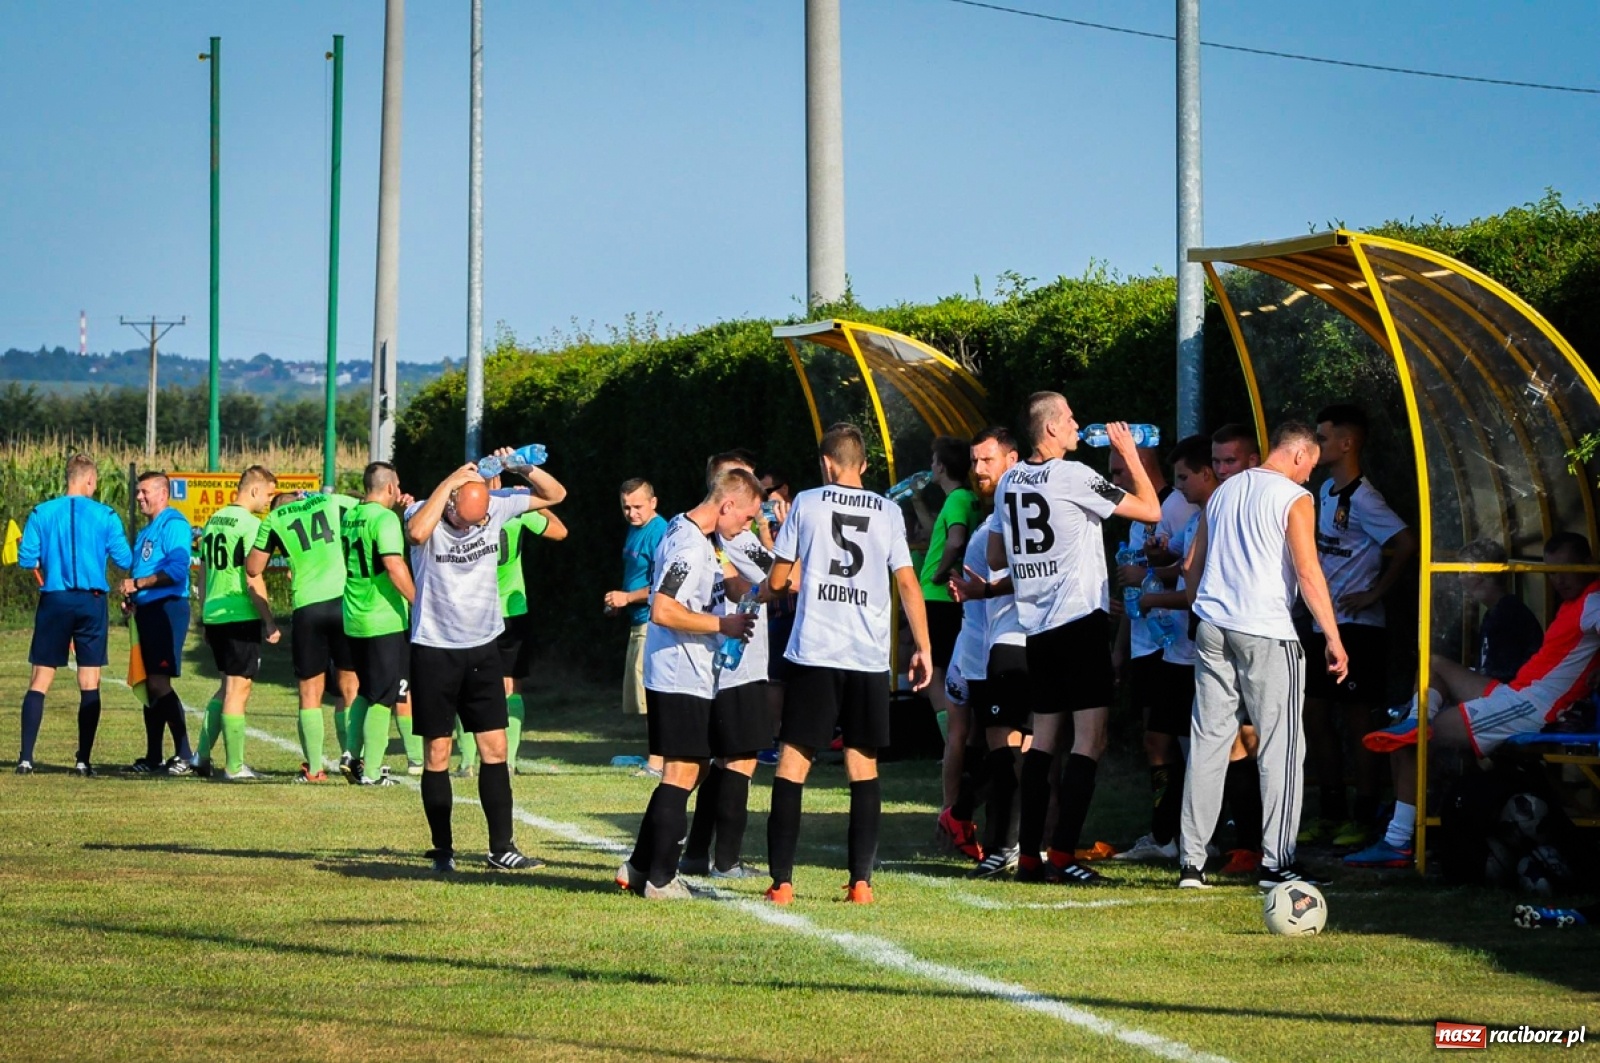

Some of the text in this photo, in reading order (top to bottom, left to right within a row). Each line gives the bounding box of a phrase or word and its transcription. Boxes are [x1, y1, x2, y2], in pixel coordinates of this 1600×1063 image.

[187, 479, 222, 488] OŚRODEK
[286, 509, 335, 552] 14
[1004, 492, 1055, 555] 13
[203, 532, 228, 571] 16
[829, 510, 870, 579] 5
[1012, 560, 1059, 579] KOBYLA
[817, 583, 868, 608] KOBYLA
